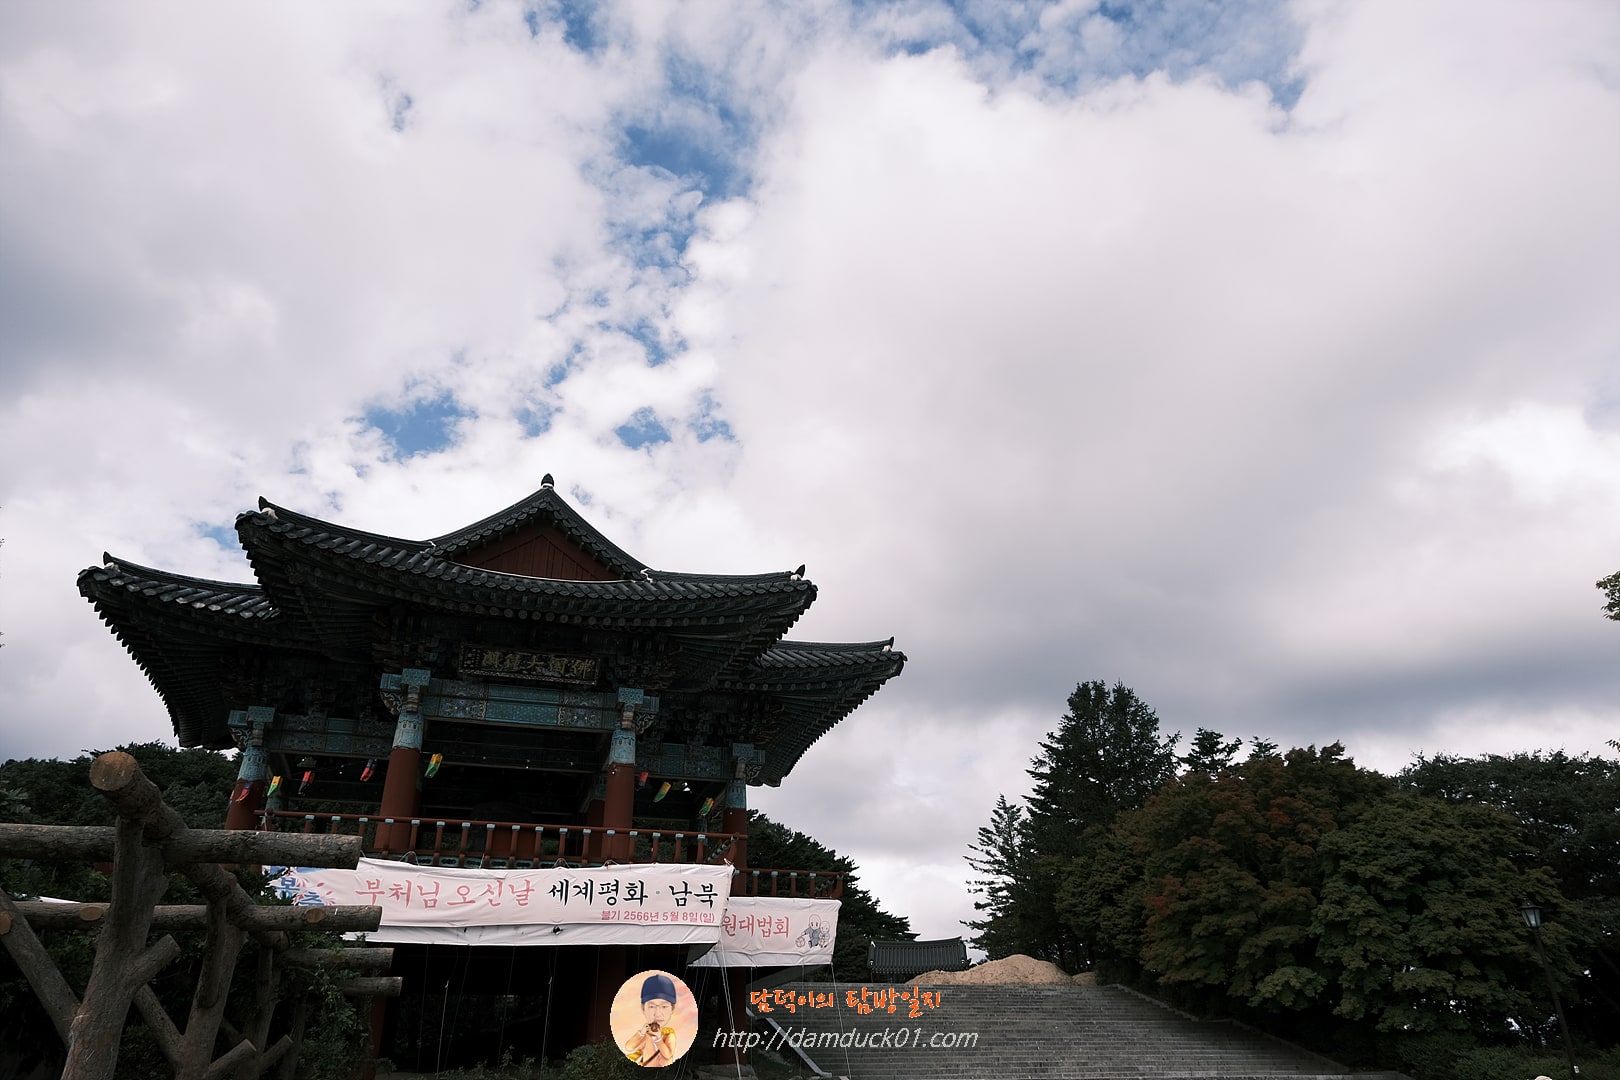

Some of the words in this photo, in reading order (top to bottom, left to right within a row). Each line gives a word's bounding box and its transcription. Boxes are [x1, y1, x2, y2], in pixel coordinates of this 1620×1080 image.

[546, 878, 649, 906] 세계평화
[668, 881, 719, 908] 남북
[601, 910, 621, 921] 불기
[624, 910, 659, 922] 2566년
[662, 911, 679, 922] 5월
